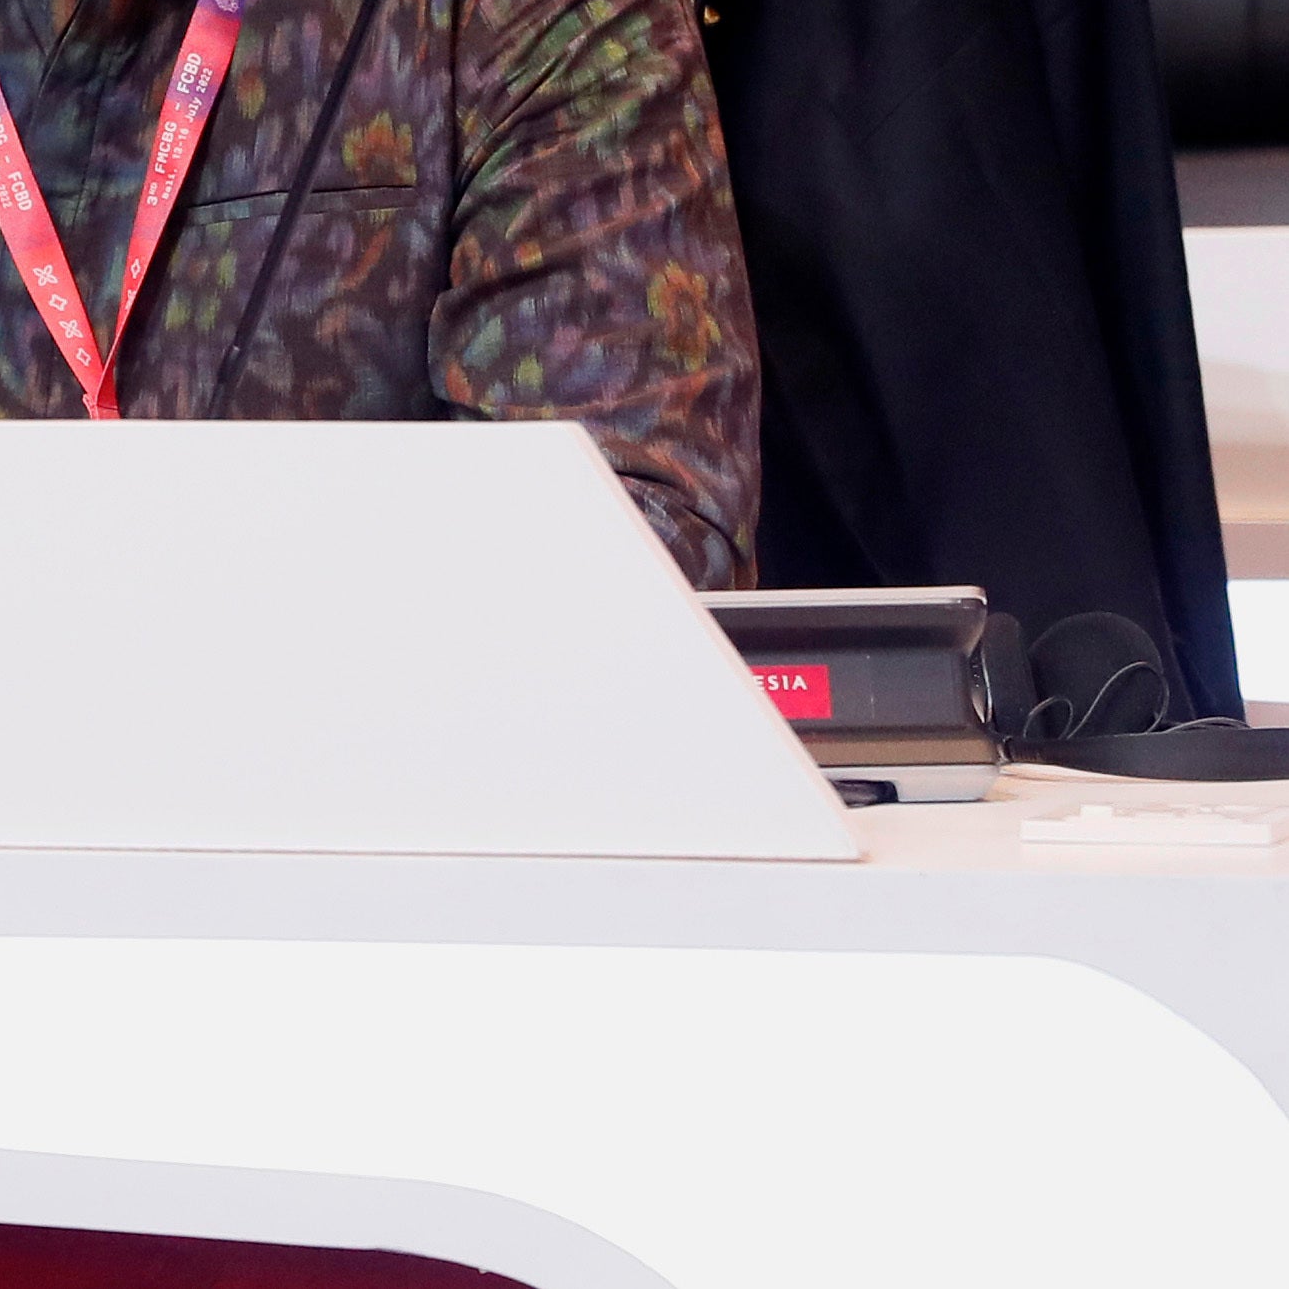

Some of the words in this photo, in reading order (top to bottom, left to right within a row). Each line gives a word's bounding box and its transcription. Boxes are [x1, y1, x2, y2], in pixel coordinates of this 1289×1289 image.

[155, 121, 177, 174] FMCBG
[176, 53, 202, 94] FCBD
[184, 97, 202, 123] July
[196, 67, 213, 94] 2022
[8, 171, 33, 211] FCBD
